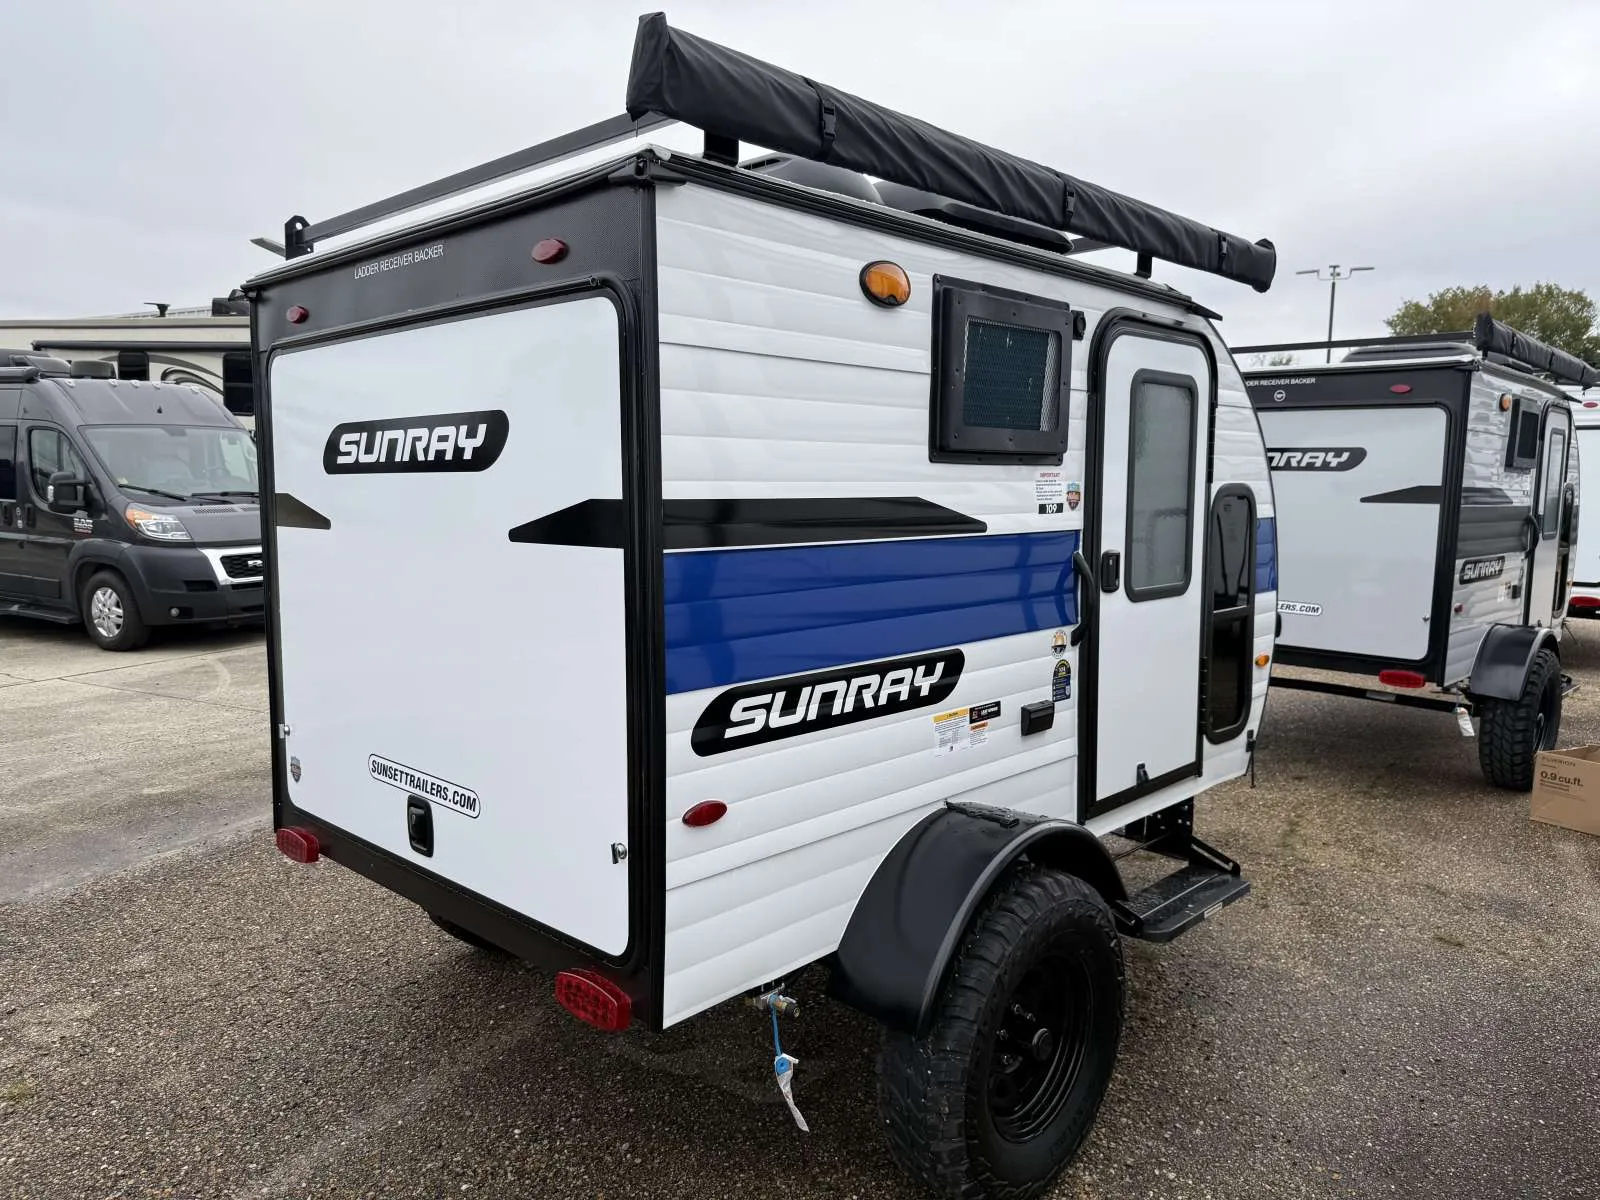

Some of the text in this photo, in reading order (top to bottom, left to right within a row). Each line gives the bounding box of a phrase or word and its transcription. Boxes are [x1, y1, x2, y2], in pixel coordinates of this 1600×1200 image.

[354, 244, 444, 279] LADDER RECEIVER BACKER
[336, 423, 488, 465] SUNRAY
[1045, 503, 1058, 514] 109
[1463, 559, 1502, 580] SUNRAY
[723, 661, 945, 739] SUNRAY
[371, 759, 477, 812] SUNSETTRAILERS.COM
[1540, 770, 1557, 781] 0.9
[1558, 775, 1584, 787] cu.ft.
